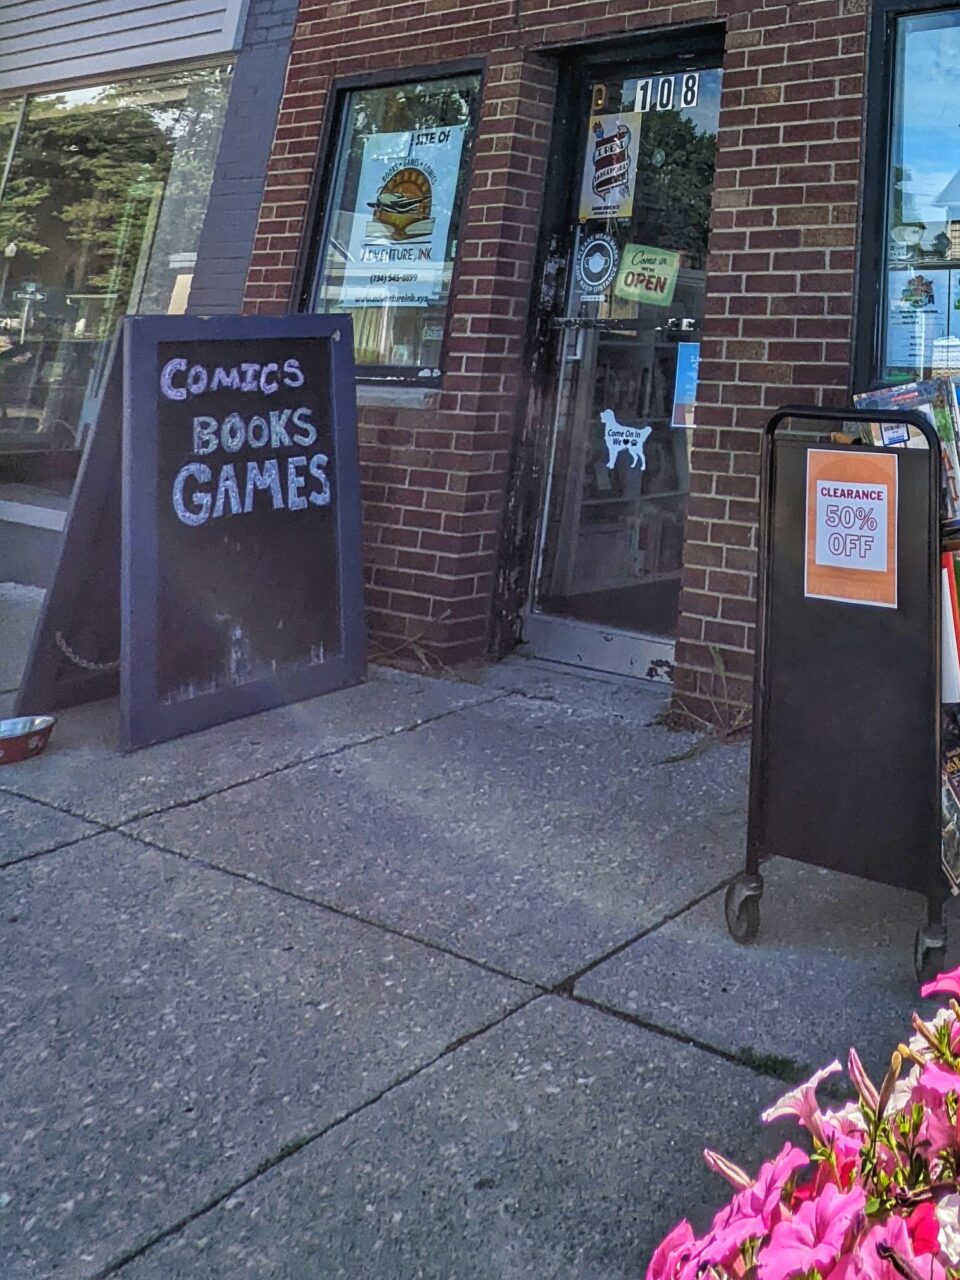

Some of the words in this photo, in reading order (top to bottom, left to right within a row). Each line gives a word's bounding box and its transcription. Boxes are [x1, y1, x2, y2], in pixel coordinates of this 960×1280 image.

[639, 74, 698, 111] 108
[416, 132, 435, 146] SITE
[382, 162, 399, 182] BOOKS
[418, 248, 432, 260] INK
[578, 235, 594, 259] PLEASE
[595, 233, 610, 241] WEAR
[631, 250, 657, 266] Come
[580, 280, 593, 291] KEEP
[594, 267, 617, 293] DISTANCE
[624, 271, 668, 294] OPEN
[160, 357, 305, 401] COMICS
[192, 407, 319, 456] BOOKS
[607, 428, 625, 438] Come
[625, 429, 634, 438] On
[612, 438, 622, 446] We
[172, 453, 331, 527] GAMES
[820, 487, 884, 501] CLEARANCE
[825, 505, 878, 532] 50%
[828, 533, 875, 559] OFF
